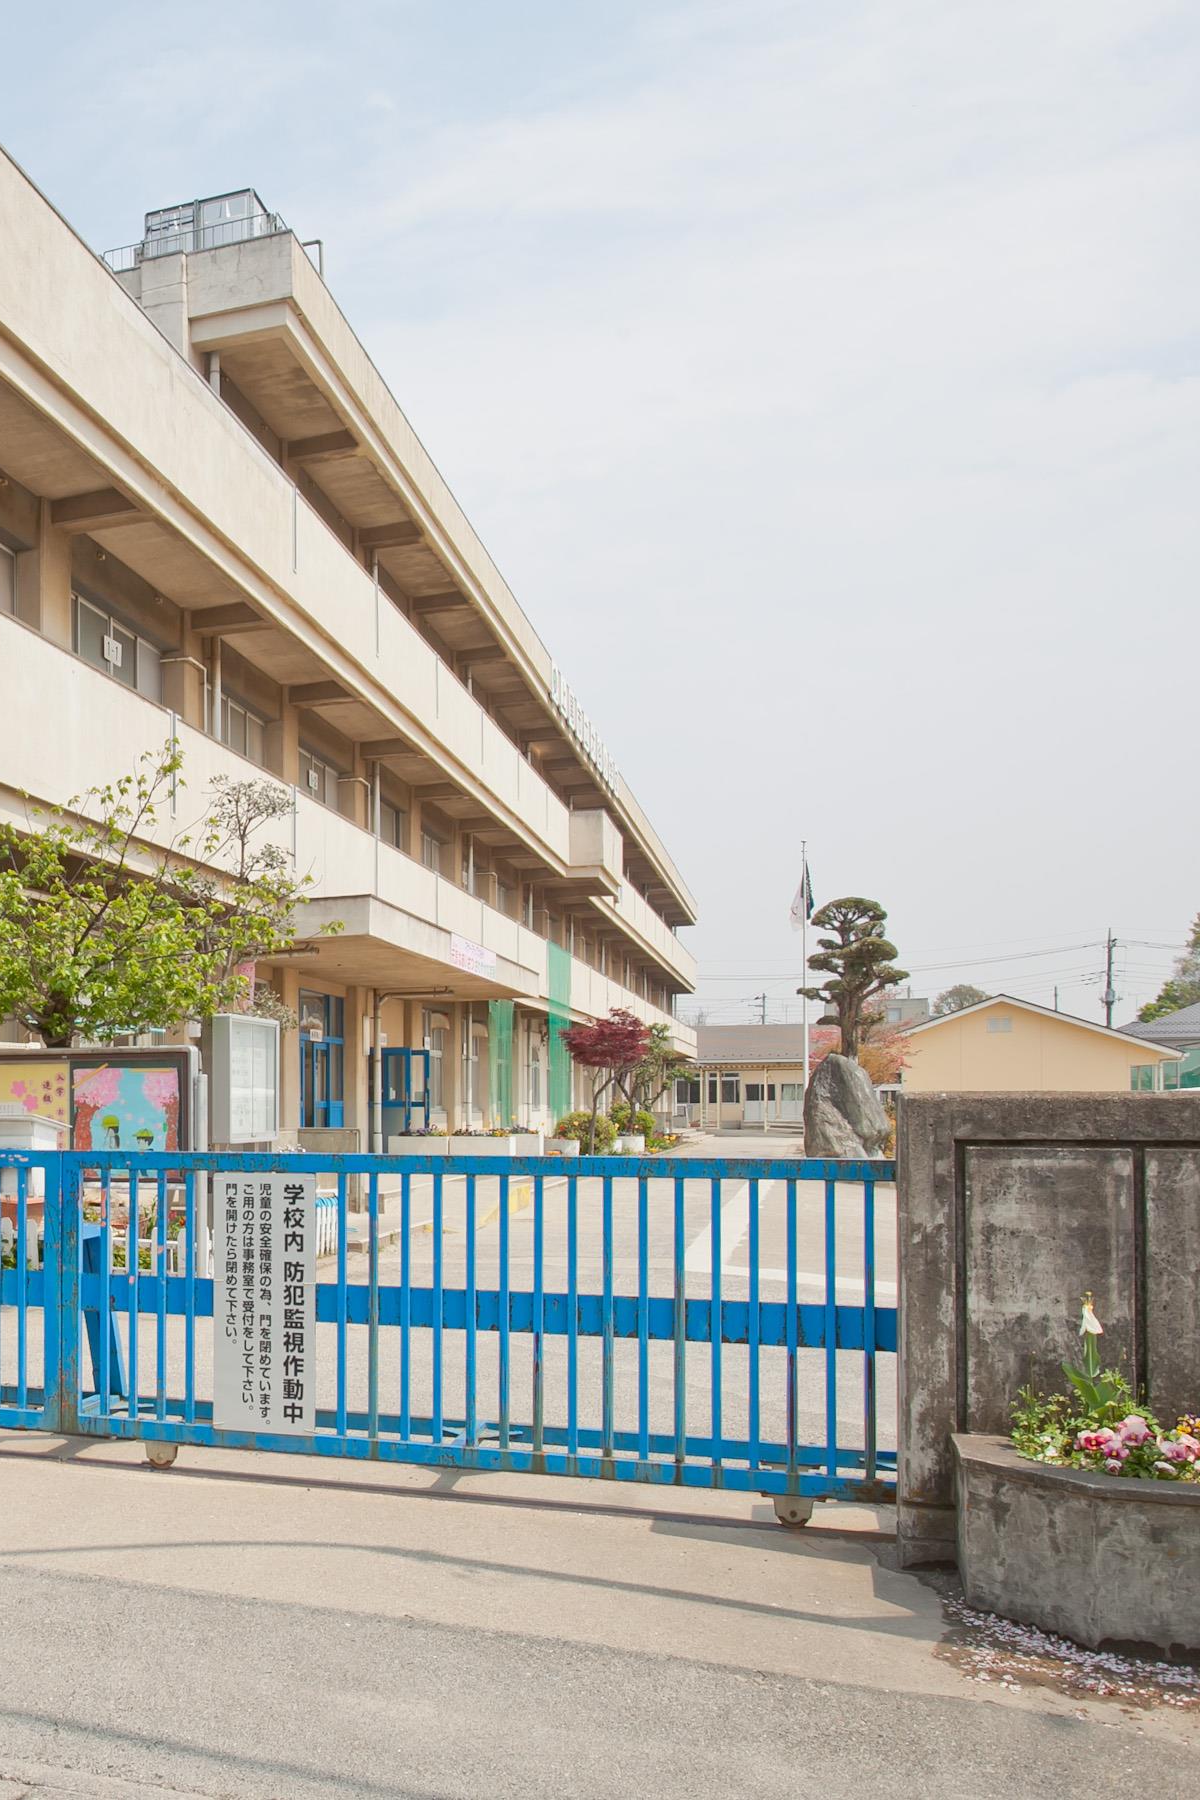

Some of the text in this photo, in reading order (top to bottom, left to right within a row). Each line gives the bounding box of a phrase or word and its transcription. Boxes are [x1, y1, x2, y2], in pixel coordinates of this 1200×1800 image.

[225, 1183, 238, 1345] 門を開けたら閉めて下さい。
[241, 1183, 255, 1411] ご用の方は事務室で受付をして下さい。
[258, 1183, 273, 1425] 児童の安全確保の為、門を閉めています。
[283, 1183, 305, 1424] 学校内 防犯監視作動中
